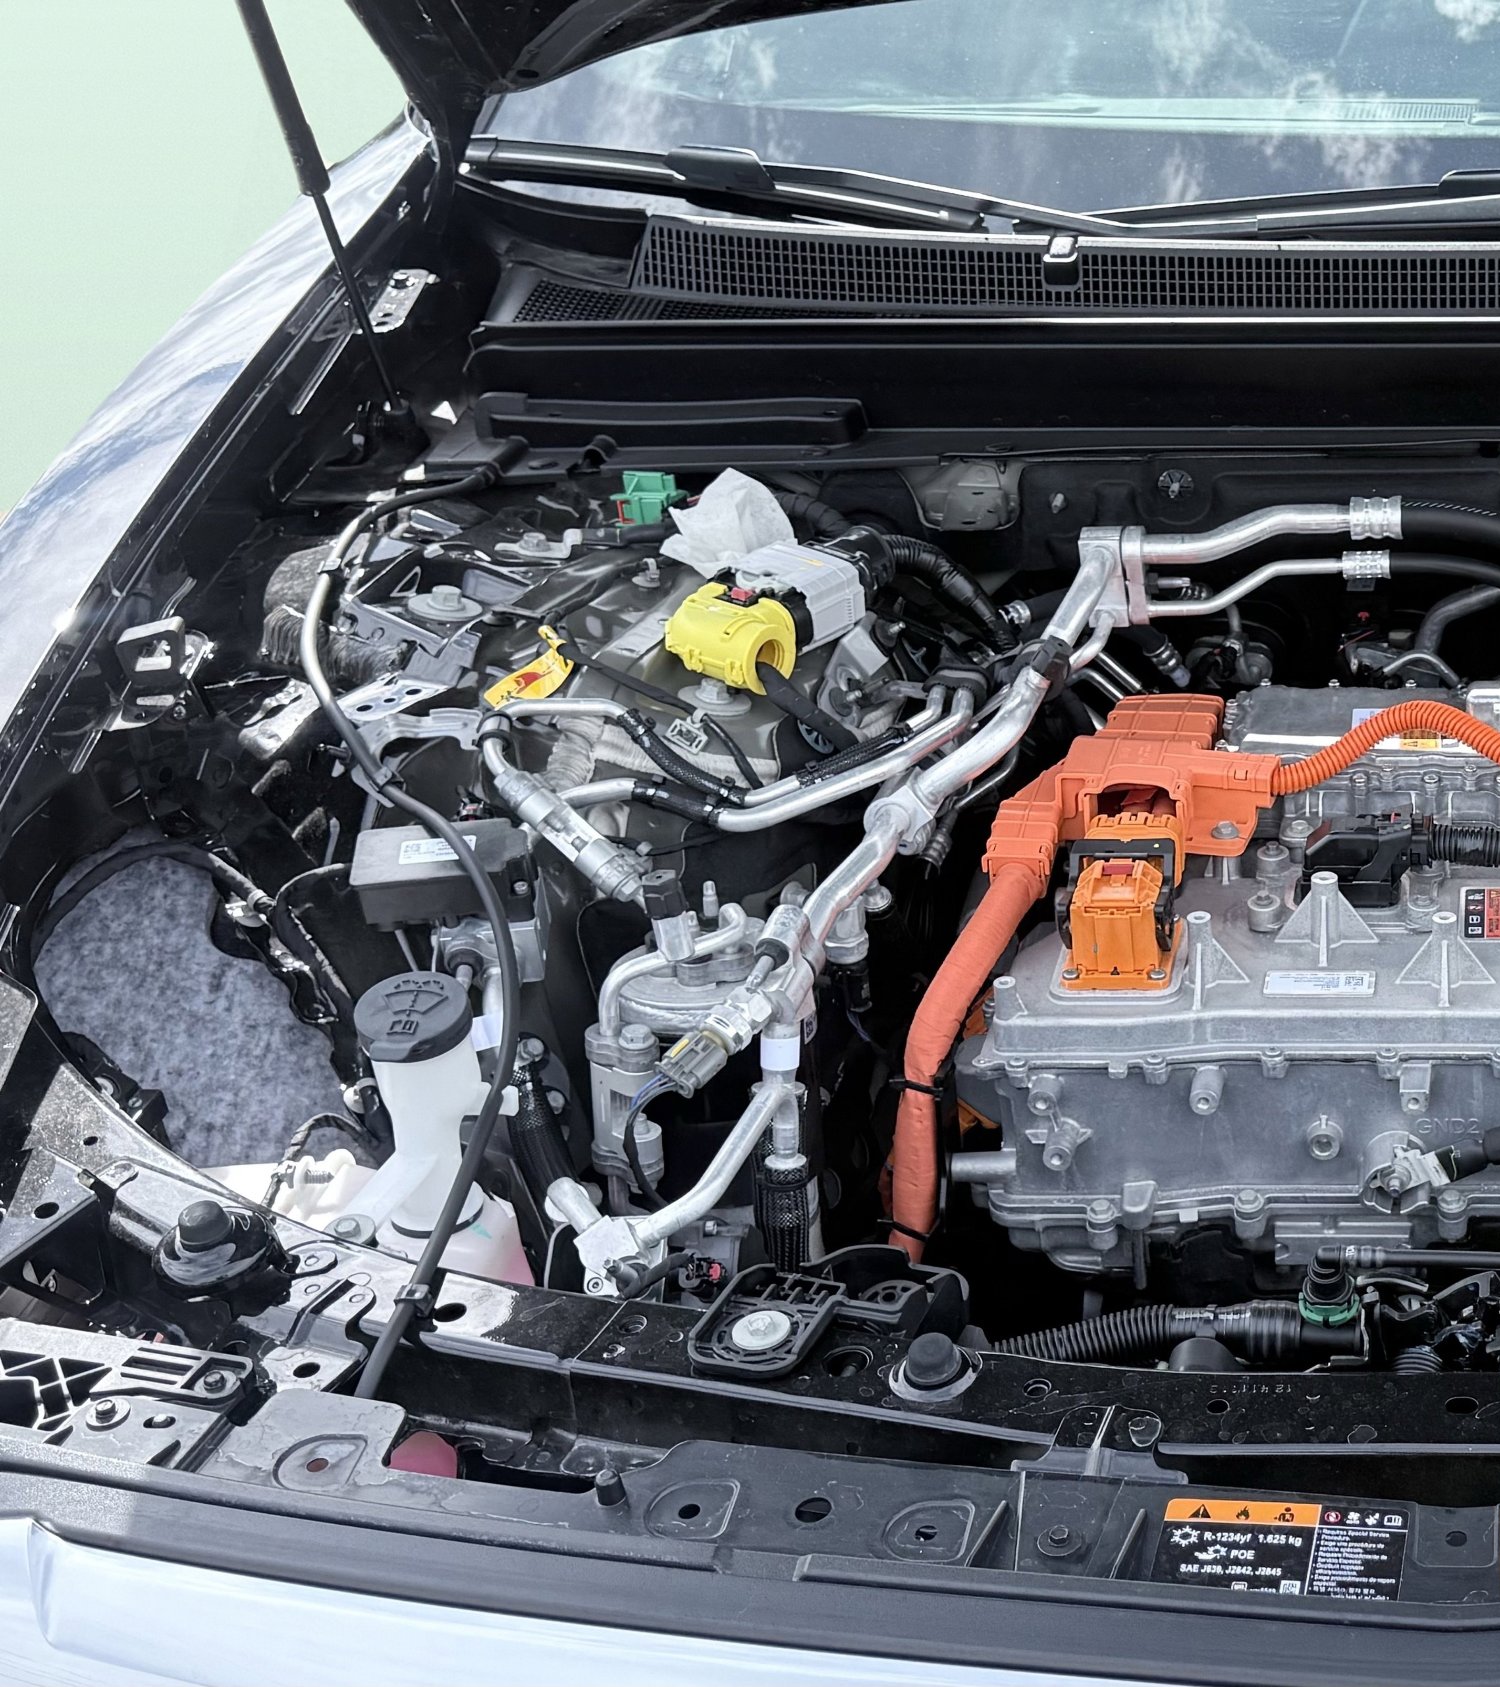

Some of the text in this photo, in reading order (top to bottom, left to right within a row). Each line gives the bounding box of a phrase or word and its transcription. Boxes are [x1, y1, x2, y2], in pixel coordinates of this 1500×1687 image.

[1415, 1117, 1480, 1134] GND2
[1203, 1531, 1302, 1547] R-1234yf 1.625 kg
[1230, 1549, 1255, 1560] POE
[1179, 1563, 1200, 1573] SAE
